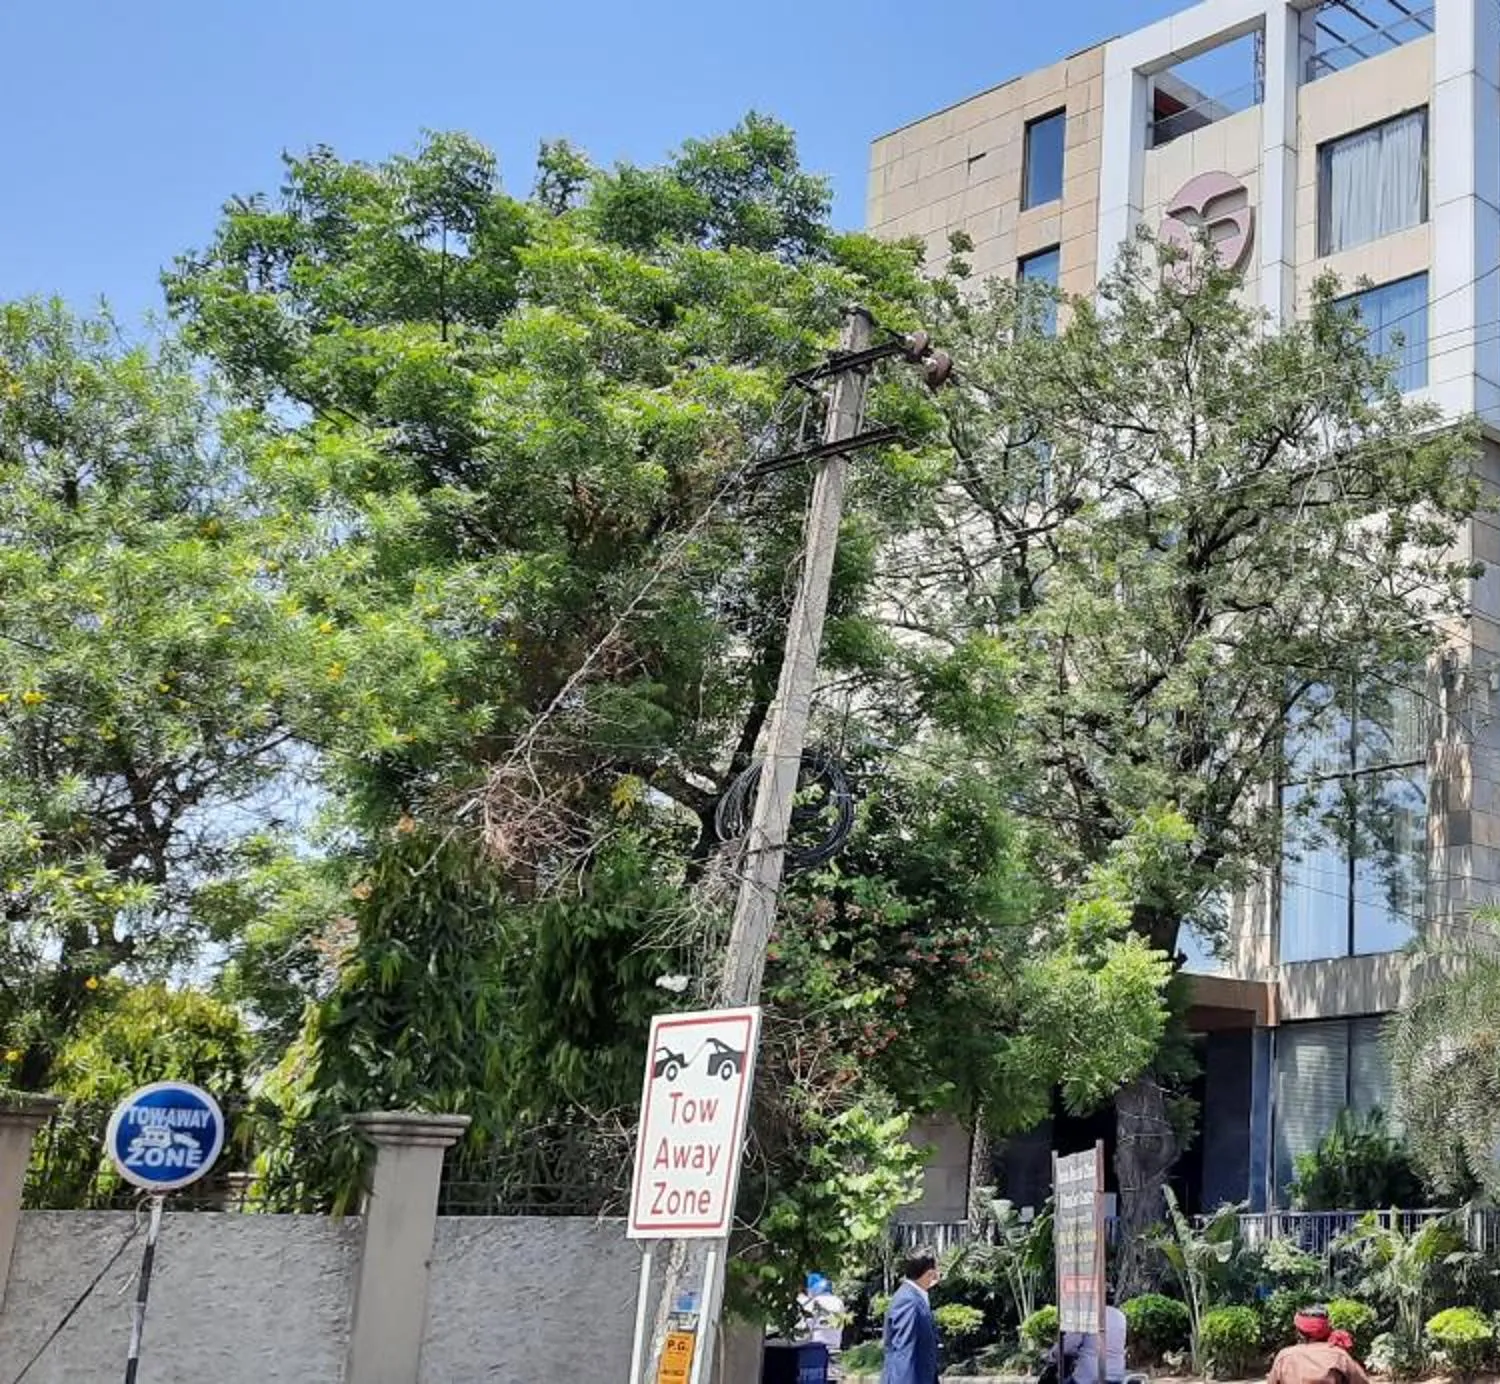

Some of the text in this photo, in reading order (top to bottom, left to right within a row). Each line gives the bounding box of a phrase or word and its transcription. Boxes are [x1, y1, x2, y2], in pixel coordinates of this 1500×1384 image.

[669, 1091, 719, 1125] Tow
[125, 1147, 203, 1168] ZONE
[653, 1137, 721, 1177] Away
[650, 1182, 712, 1216] Zone
